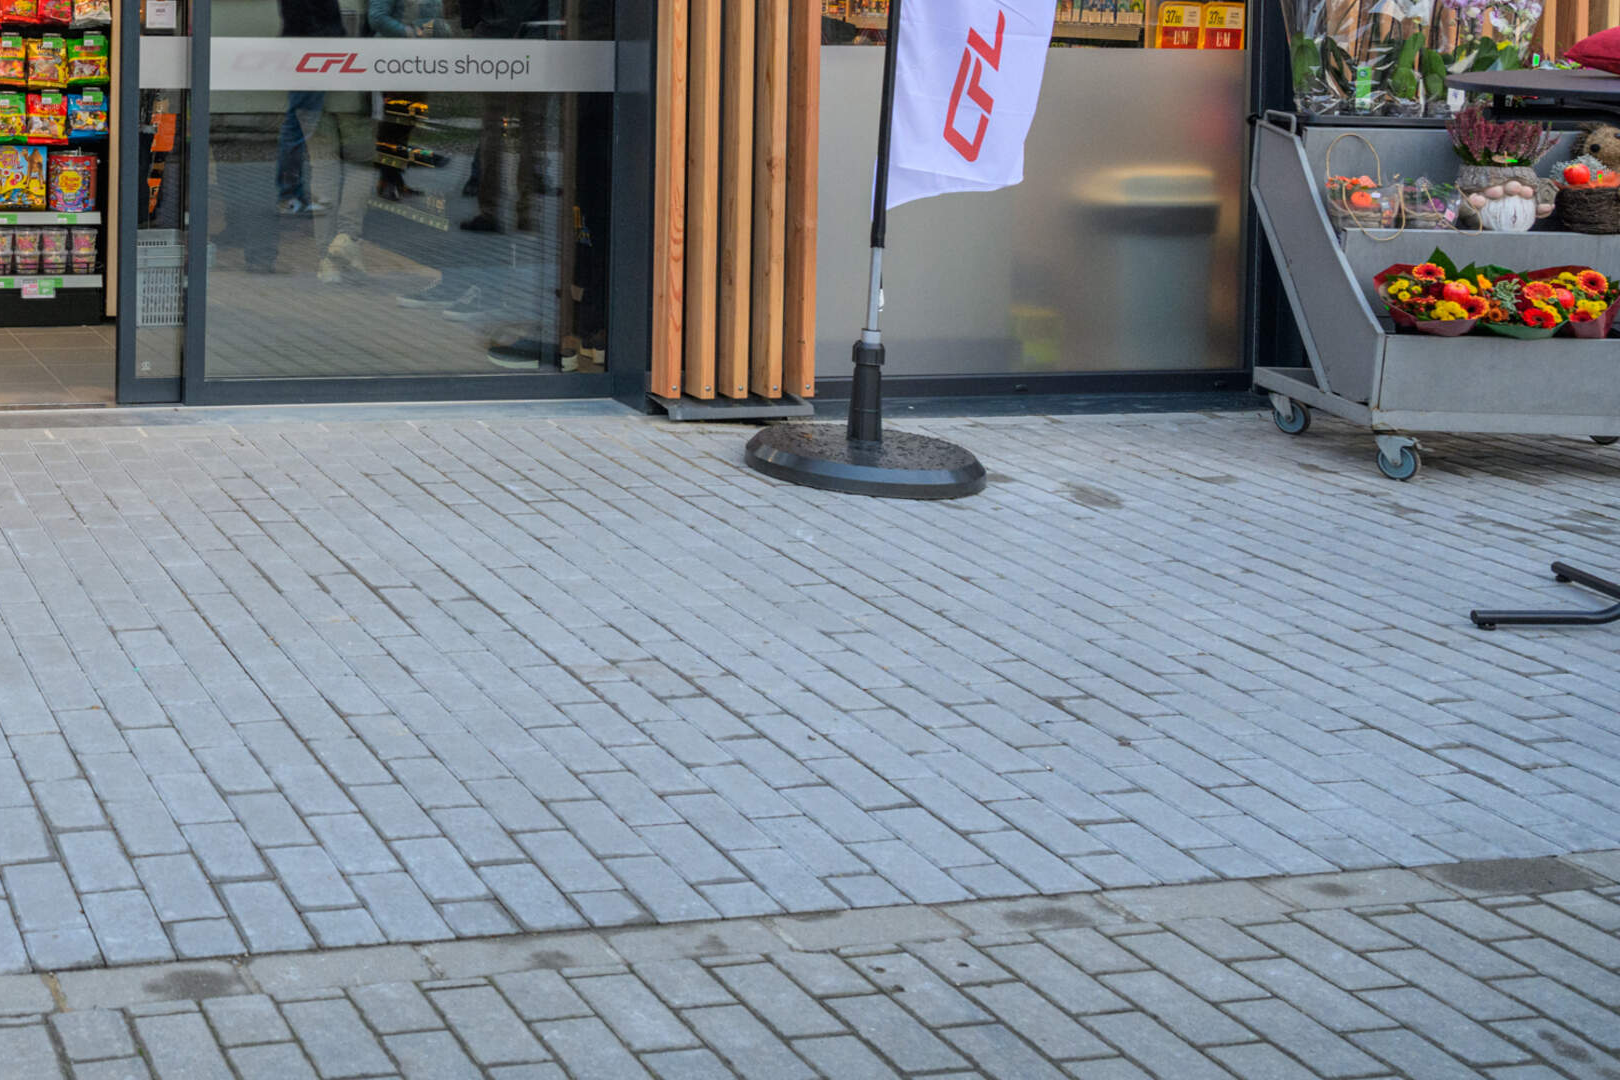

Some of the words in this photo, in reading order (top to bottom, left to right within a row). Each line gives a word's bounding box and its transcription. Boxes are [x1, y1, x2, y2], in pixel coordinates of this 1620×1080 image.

[295, 52, 368, 73] CFL
[374, 56, 449, 75] cactus
[454, 54, 531, 81] shoppi
[943, 9, 1006, 162] CFL
